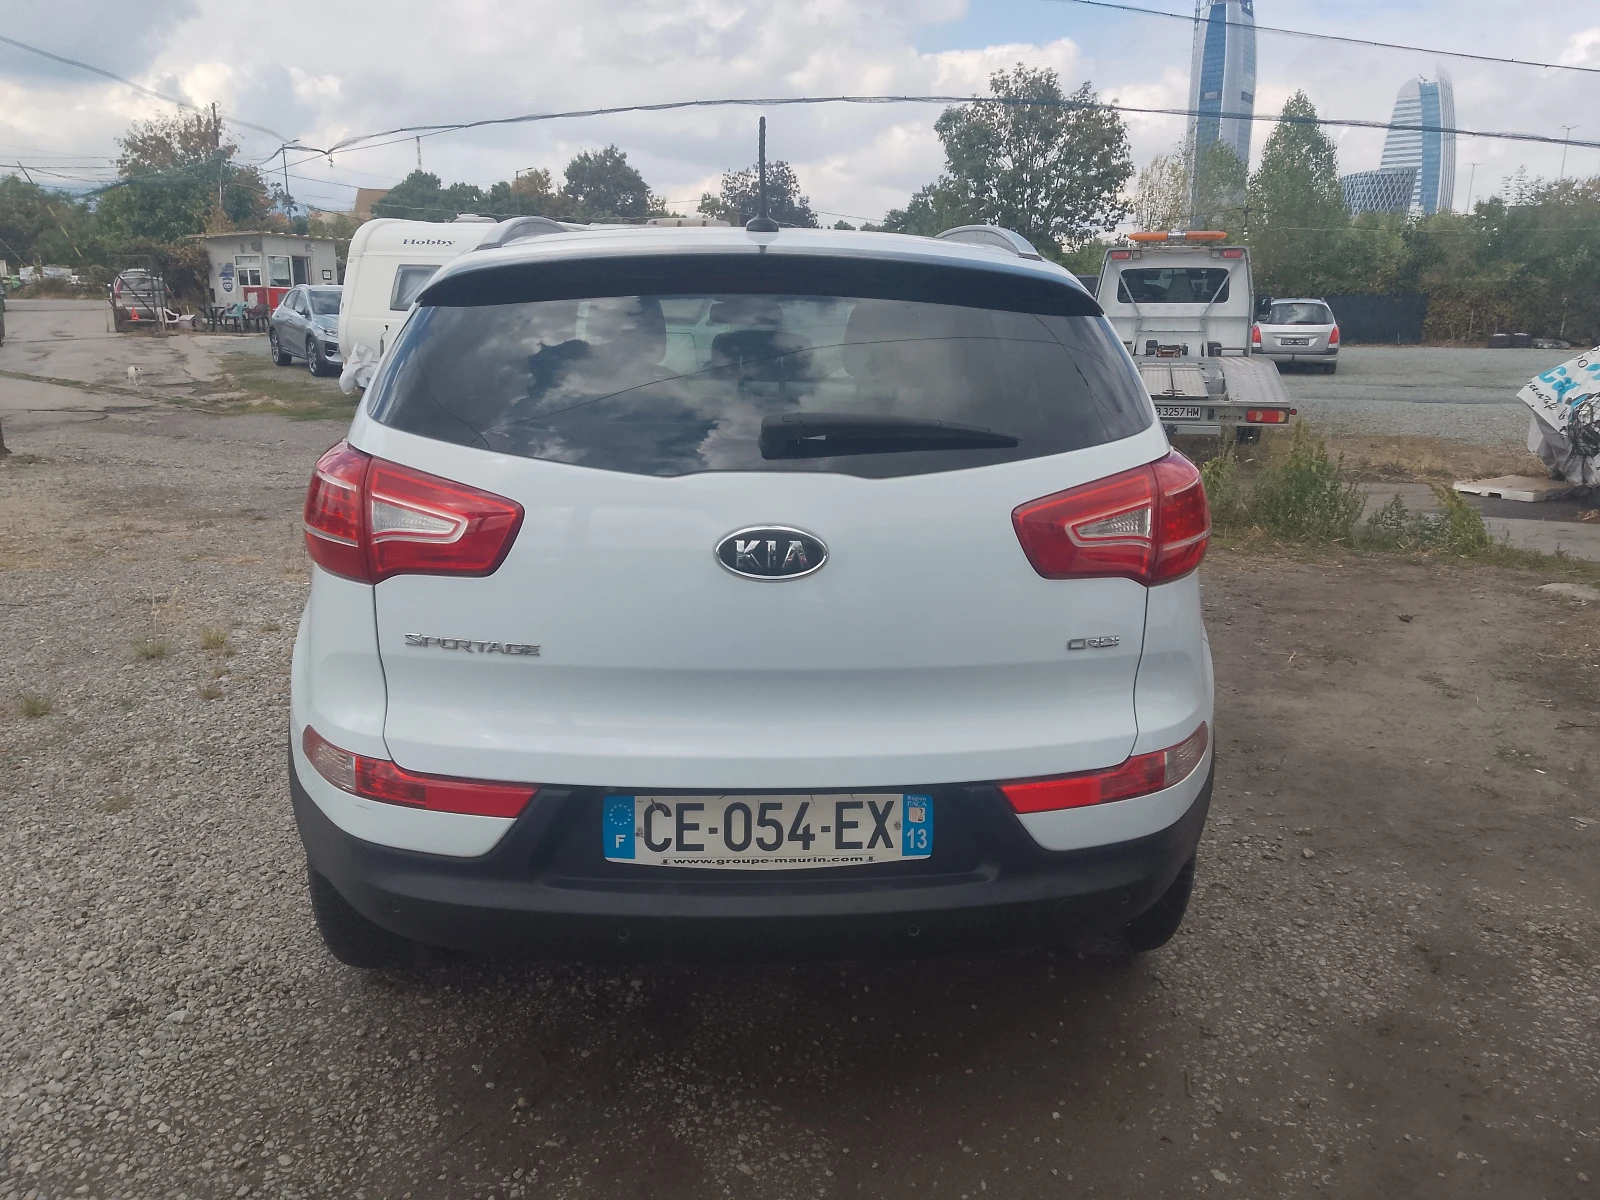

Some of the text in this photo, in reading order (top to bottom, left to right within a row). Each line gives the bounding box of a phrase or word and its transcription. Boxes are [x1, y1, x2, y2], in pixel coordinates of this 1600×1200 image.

[403, 238, 456, 247] Hobby
[735, 539, 810, 568] KIA
[404, 632, 540, 656] SPORTAGE
[643, 800, 895, 852] CE-054-EX
[615, 835, 626, 848] F
[907, 828, 927, 849] 13
[673, 856, 863, 865] www.groupe-maurin.com
